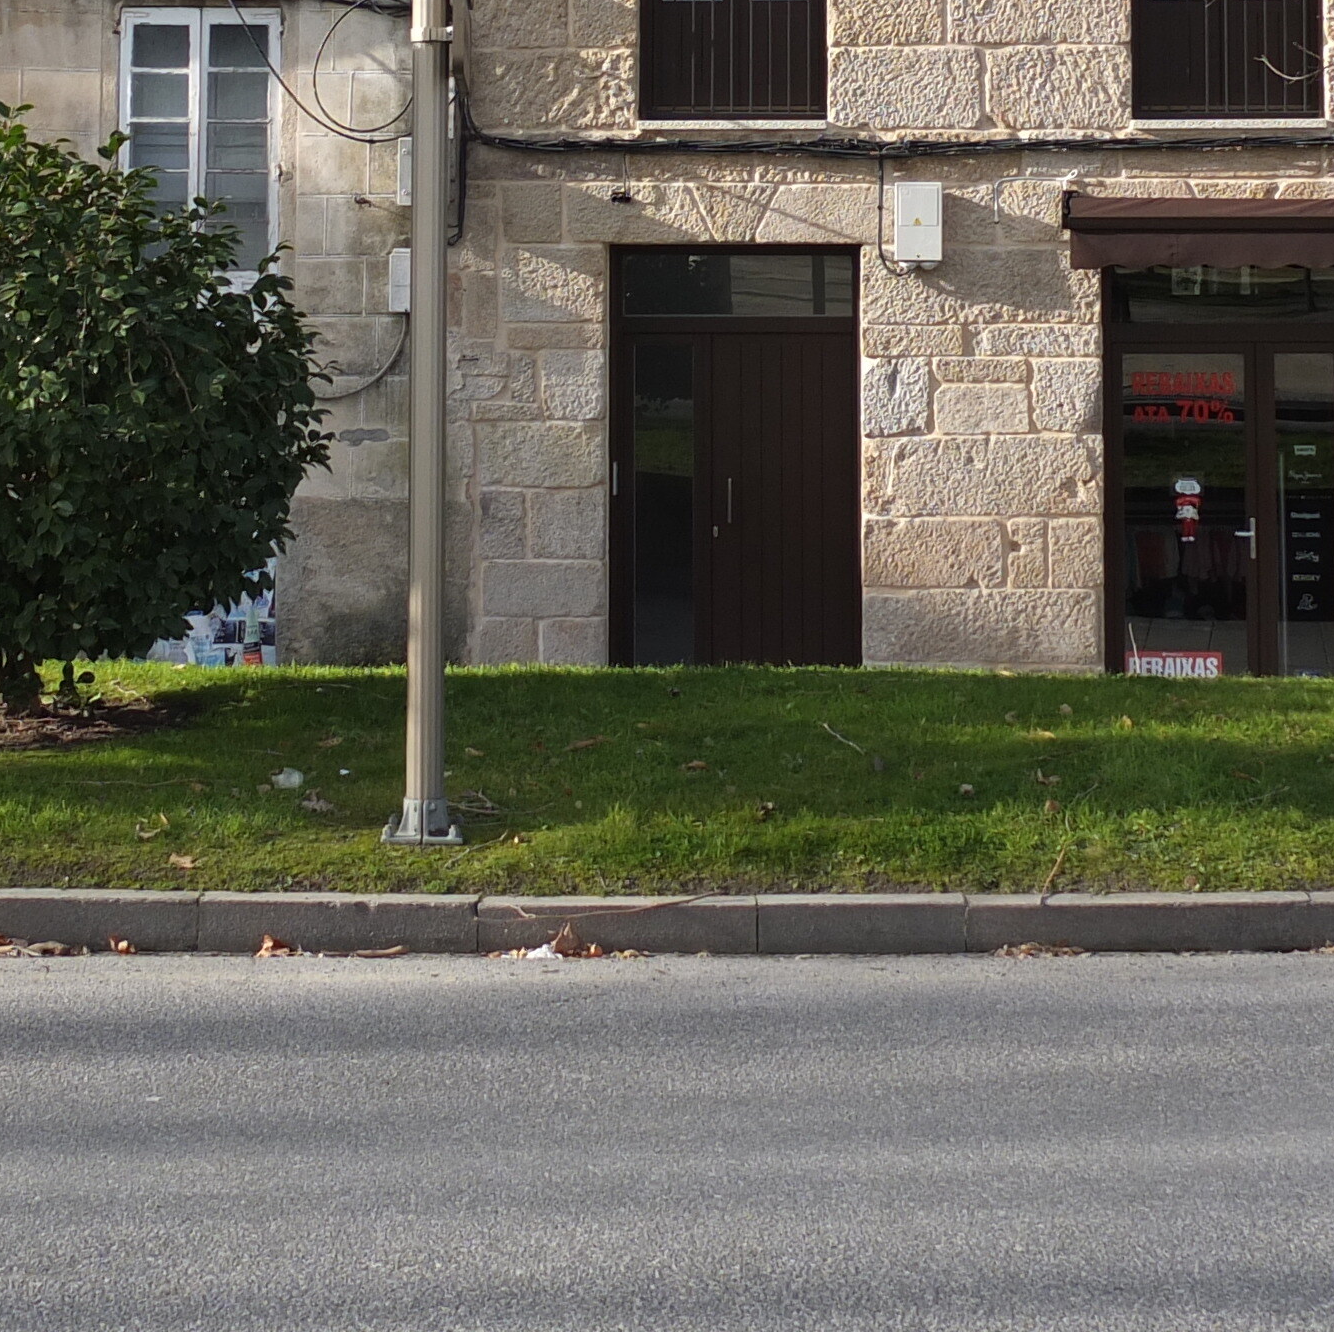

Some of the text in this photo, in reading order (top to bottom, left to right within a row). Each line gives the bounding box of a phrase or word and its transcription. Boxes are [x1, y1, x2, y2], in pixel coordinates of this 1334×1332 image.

[1132, 372, 1236, 395] REBAIXAS
[1132, 399, 1234, 424] ATA 70%
